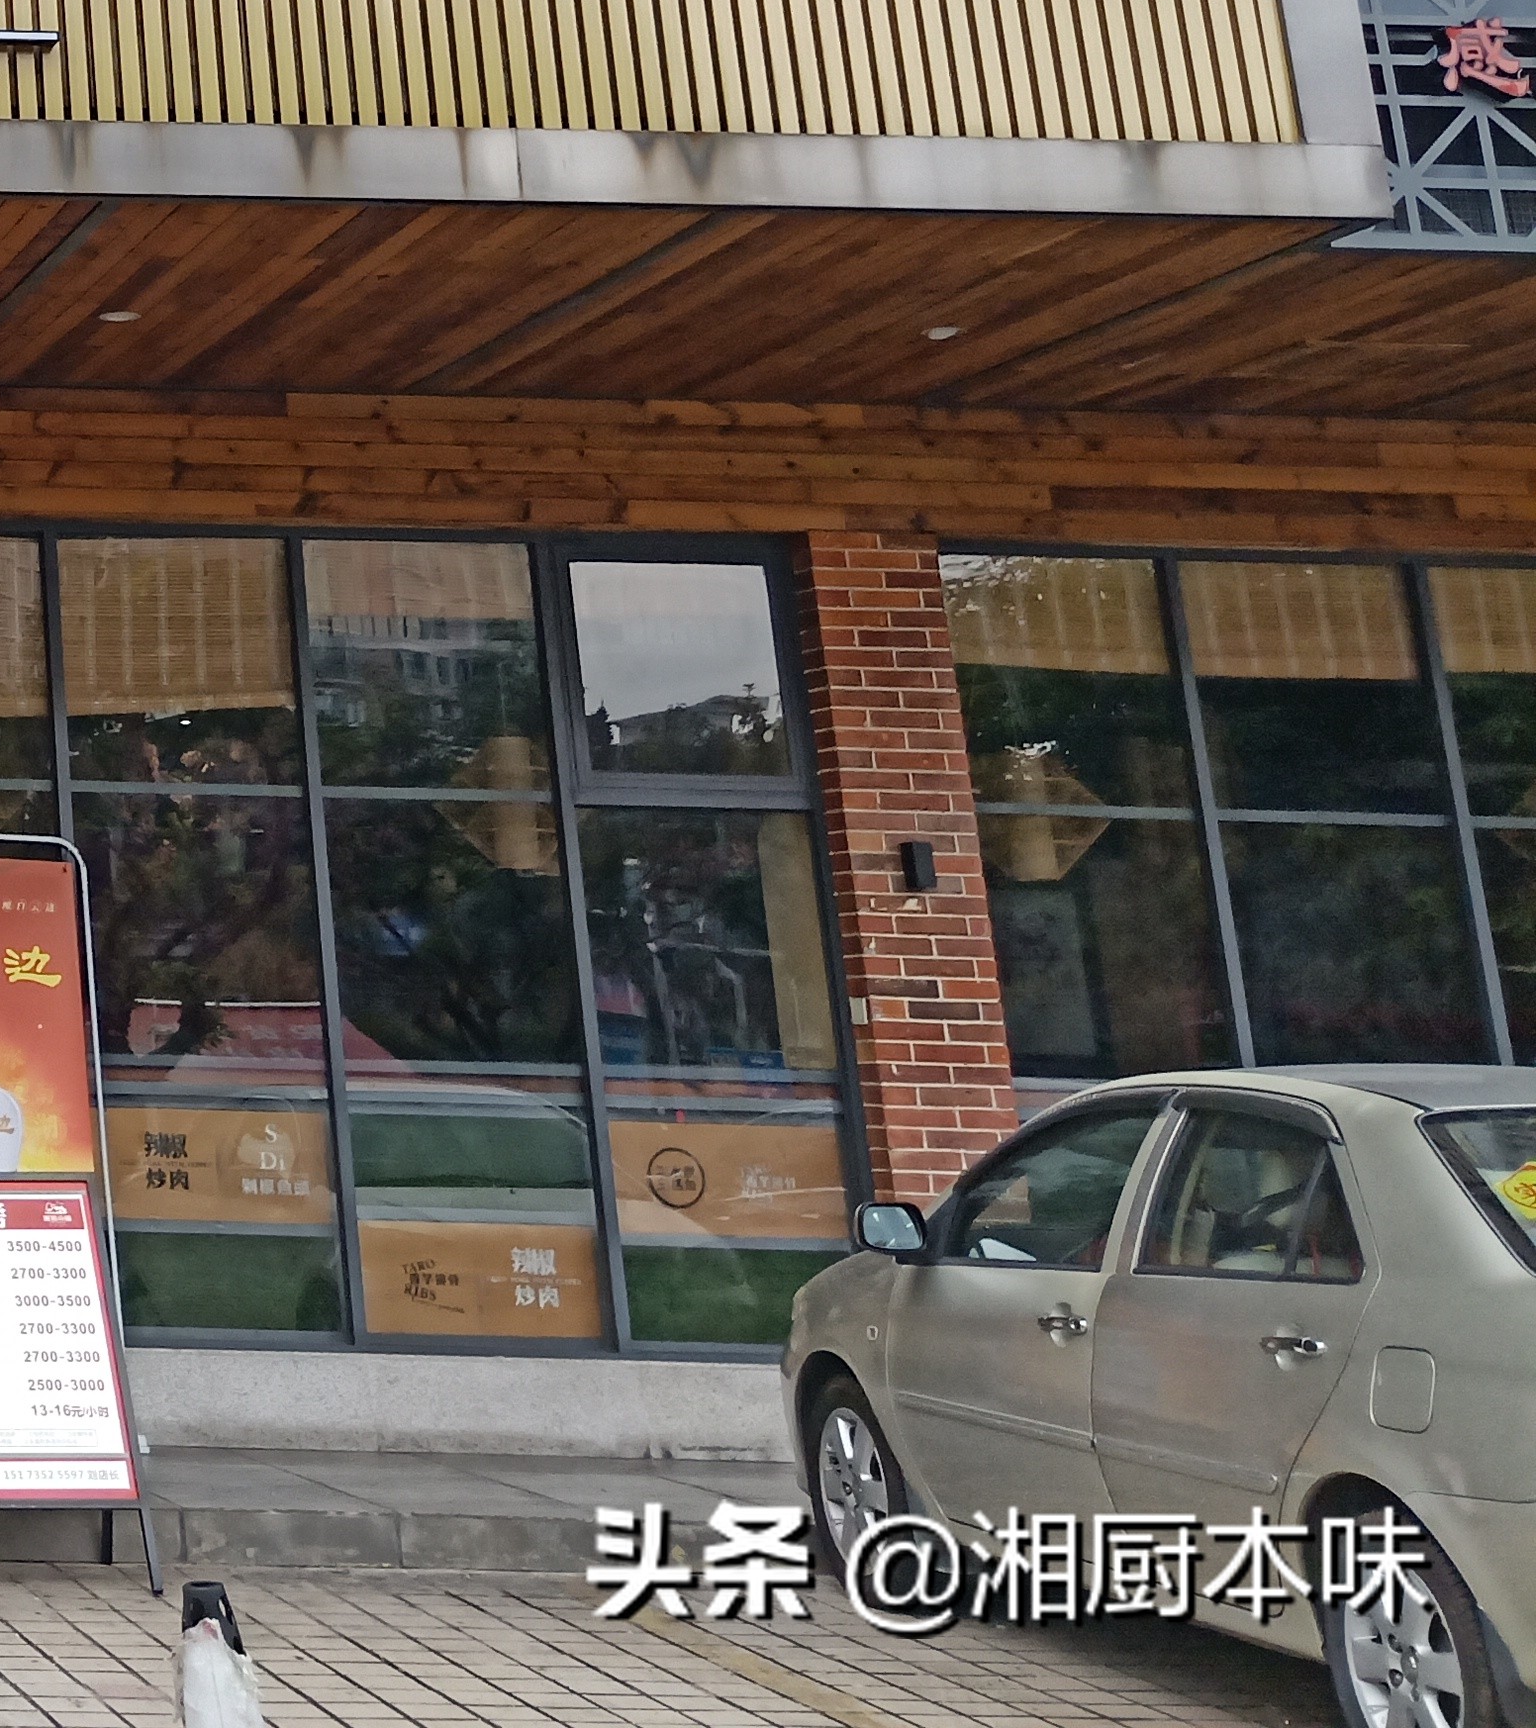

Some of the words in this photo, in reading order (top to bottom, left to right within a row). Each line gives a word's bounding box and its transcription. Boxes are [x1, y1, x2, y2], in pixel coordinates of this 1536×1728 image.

[7, 1240, 82, 1252] 3500-4500
[11, 1267, 87, 1280] 2700-3300
[14, 1294, 91, 1307] 3000-3500
[19, 1323, 96, 1335] 2700-3300
[24, 1350, 100, 1363] 2700-3300
[28, 1379, 105, 1391] 2500-3000
